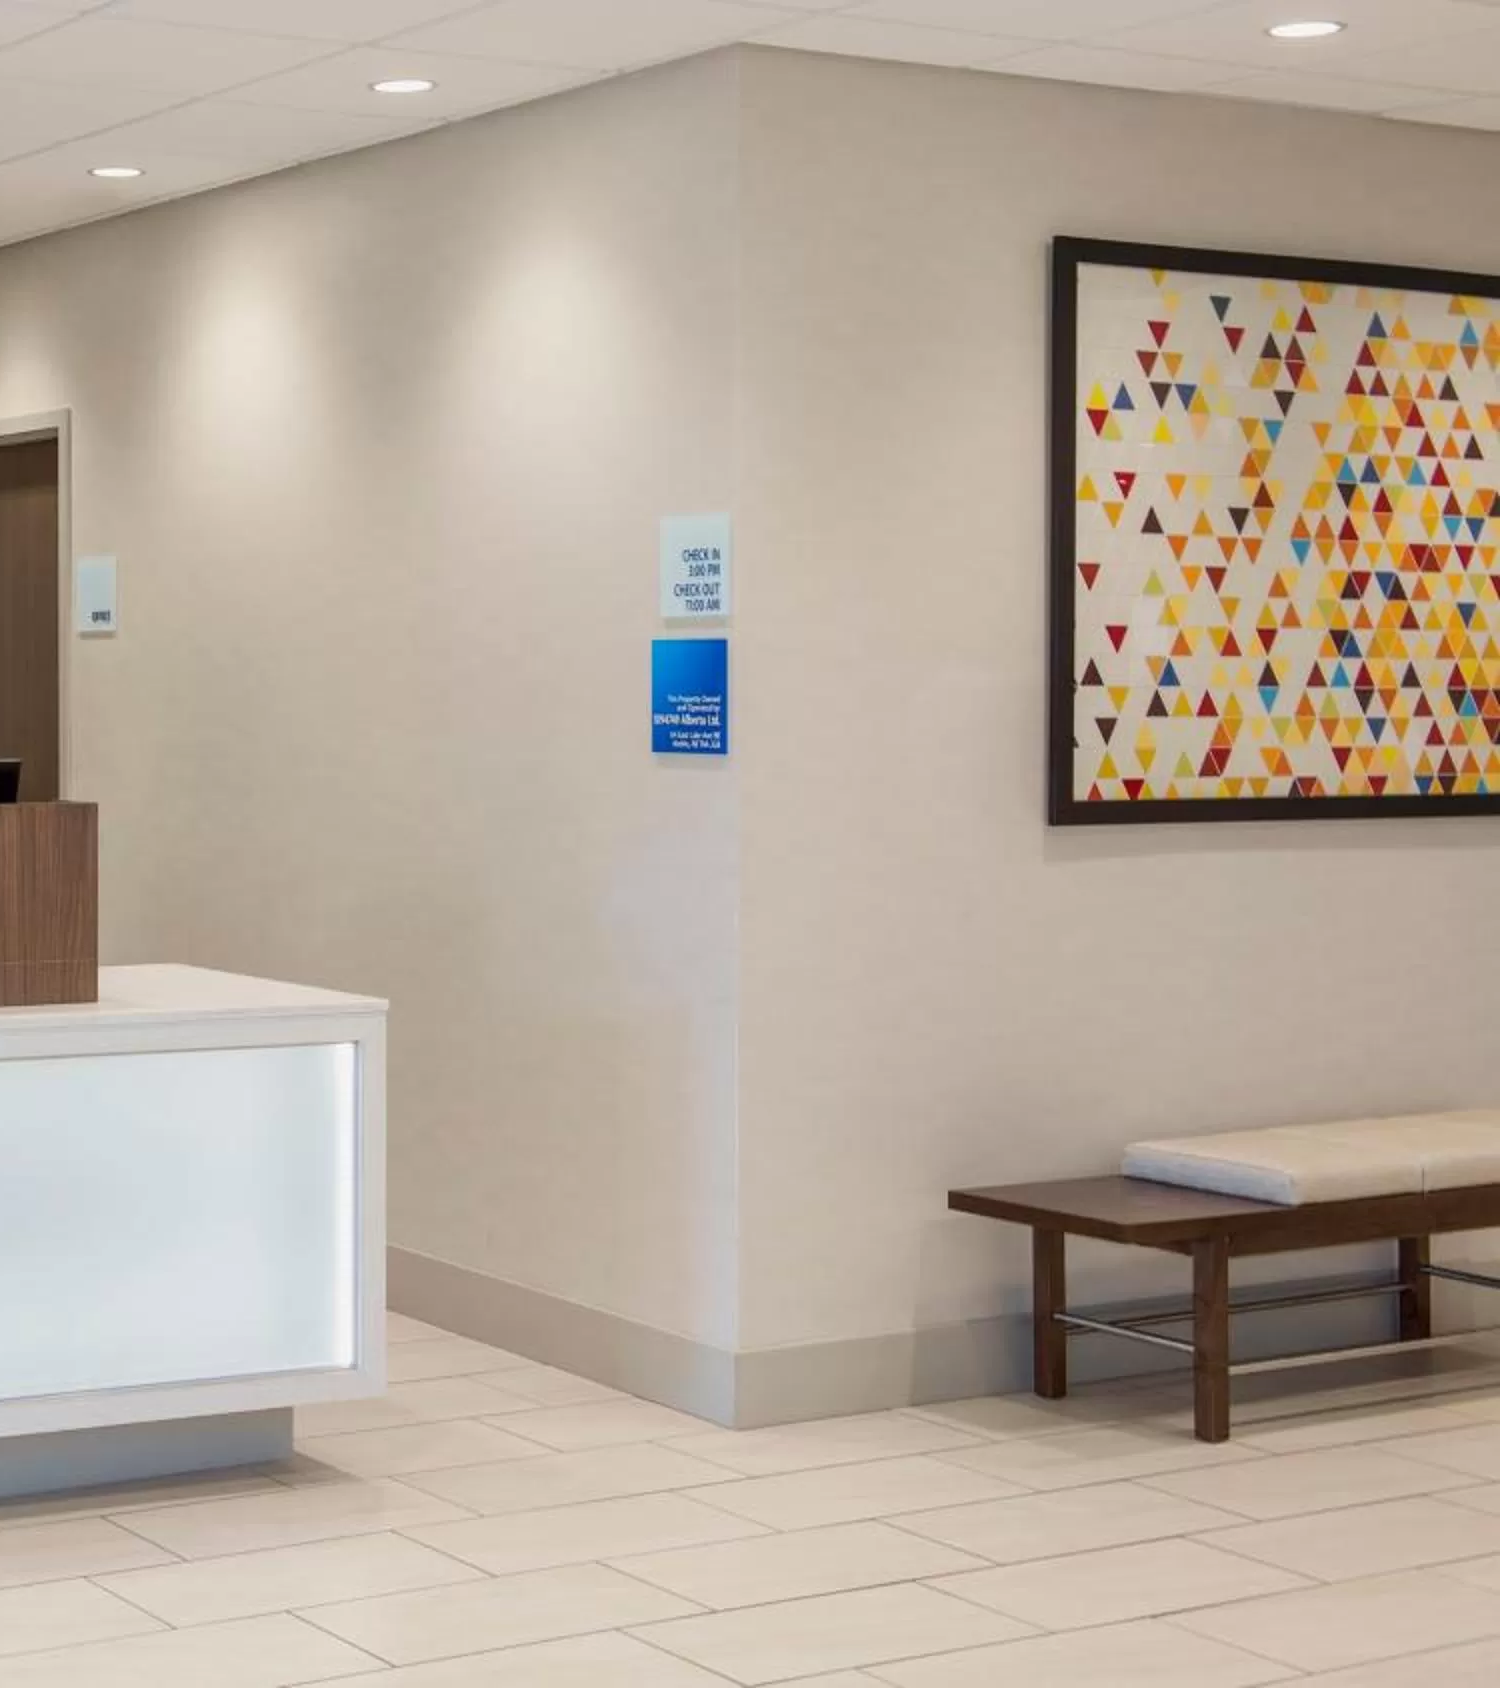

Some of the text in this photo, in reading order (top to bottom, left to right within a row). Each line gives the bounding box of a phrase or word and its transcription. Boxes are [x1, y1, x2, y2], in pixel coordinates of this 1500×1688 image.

[682, 547, 721, 563] CHECK IN
[707, 563, 721, 577] PM
[673, 582, 721, 597] CHECK OUT
[706, 598, 721, 611] AM
